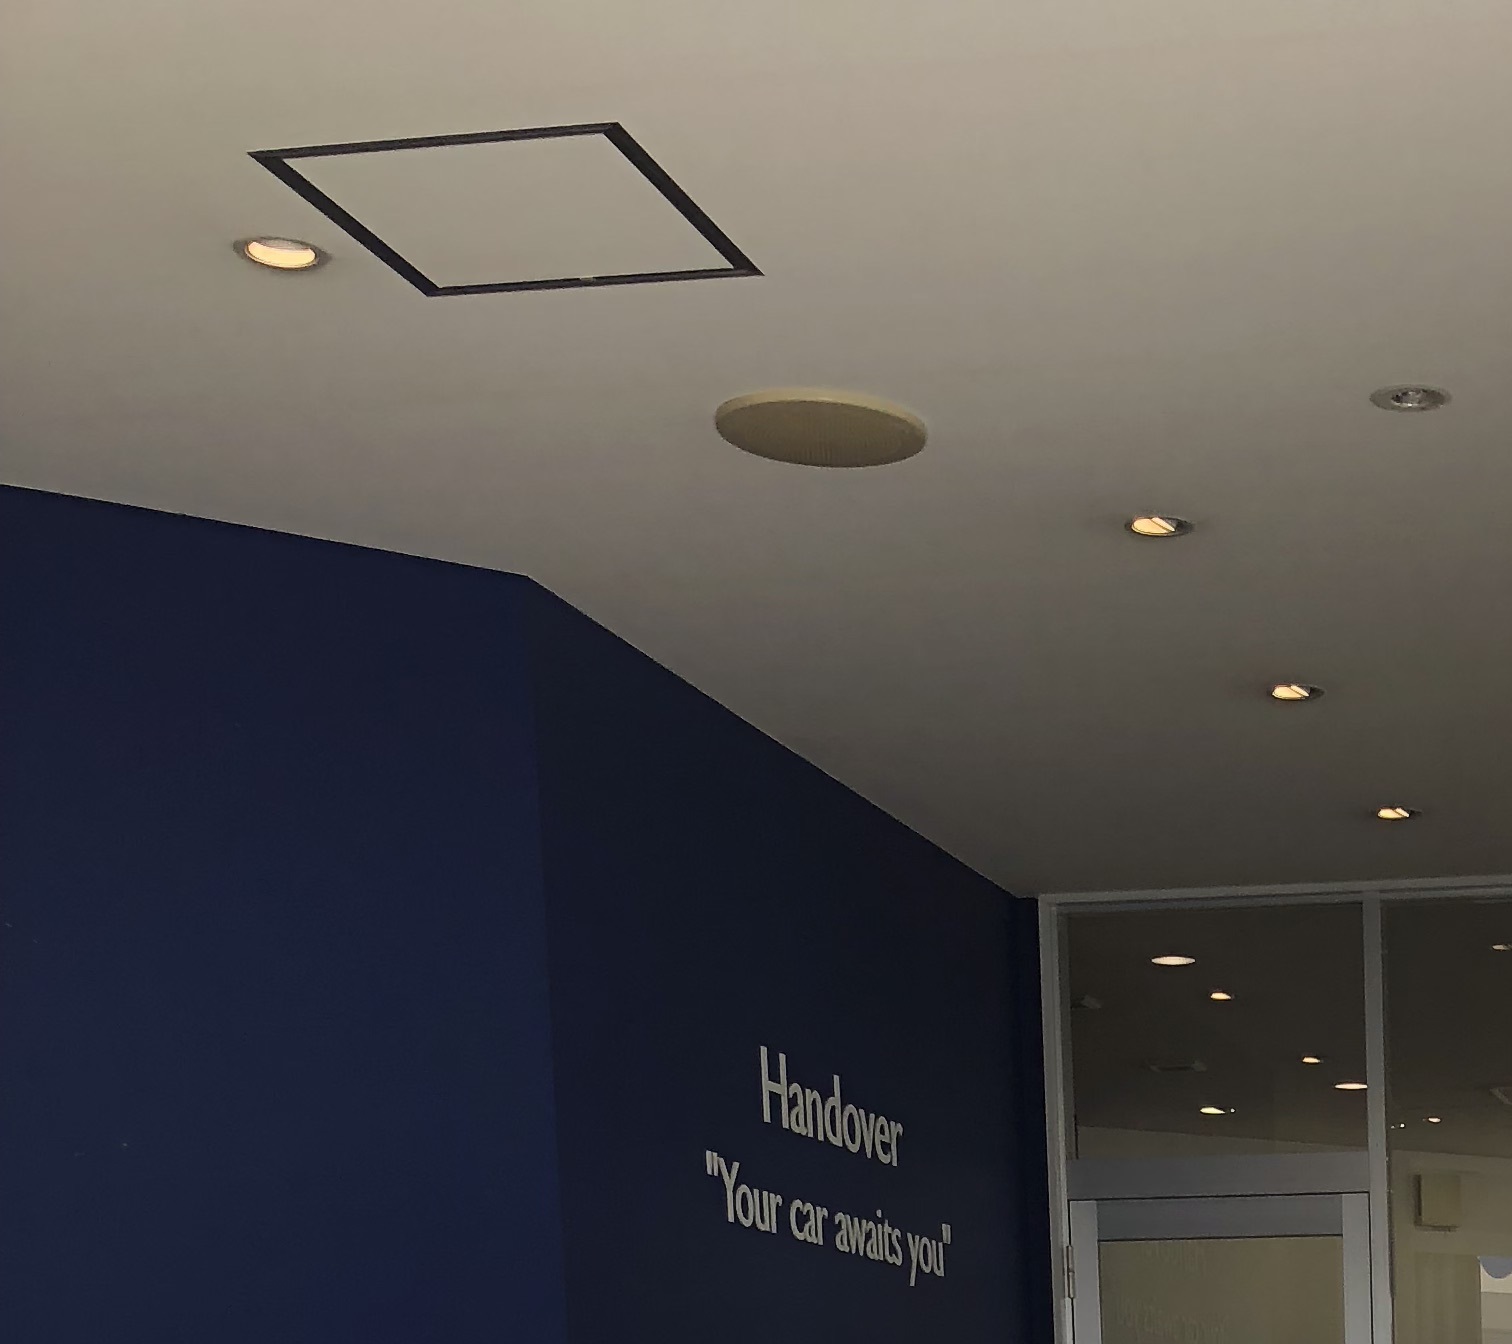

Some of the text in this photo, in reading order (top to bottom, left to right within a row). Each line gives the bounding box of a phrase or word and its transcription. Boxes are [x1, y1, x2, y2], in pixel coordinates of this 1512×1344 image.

[758, 1045, 904, 1168] Handover
[705, 1149, 952, 1288] "Your car awaits you"
